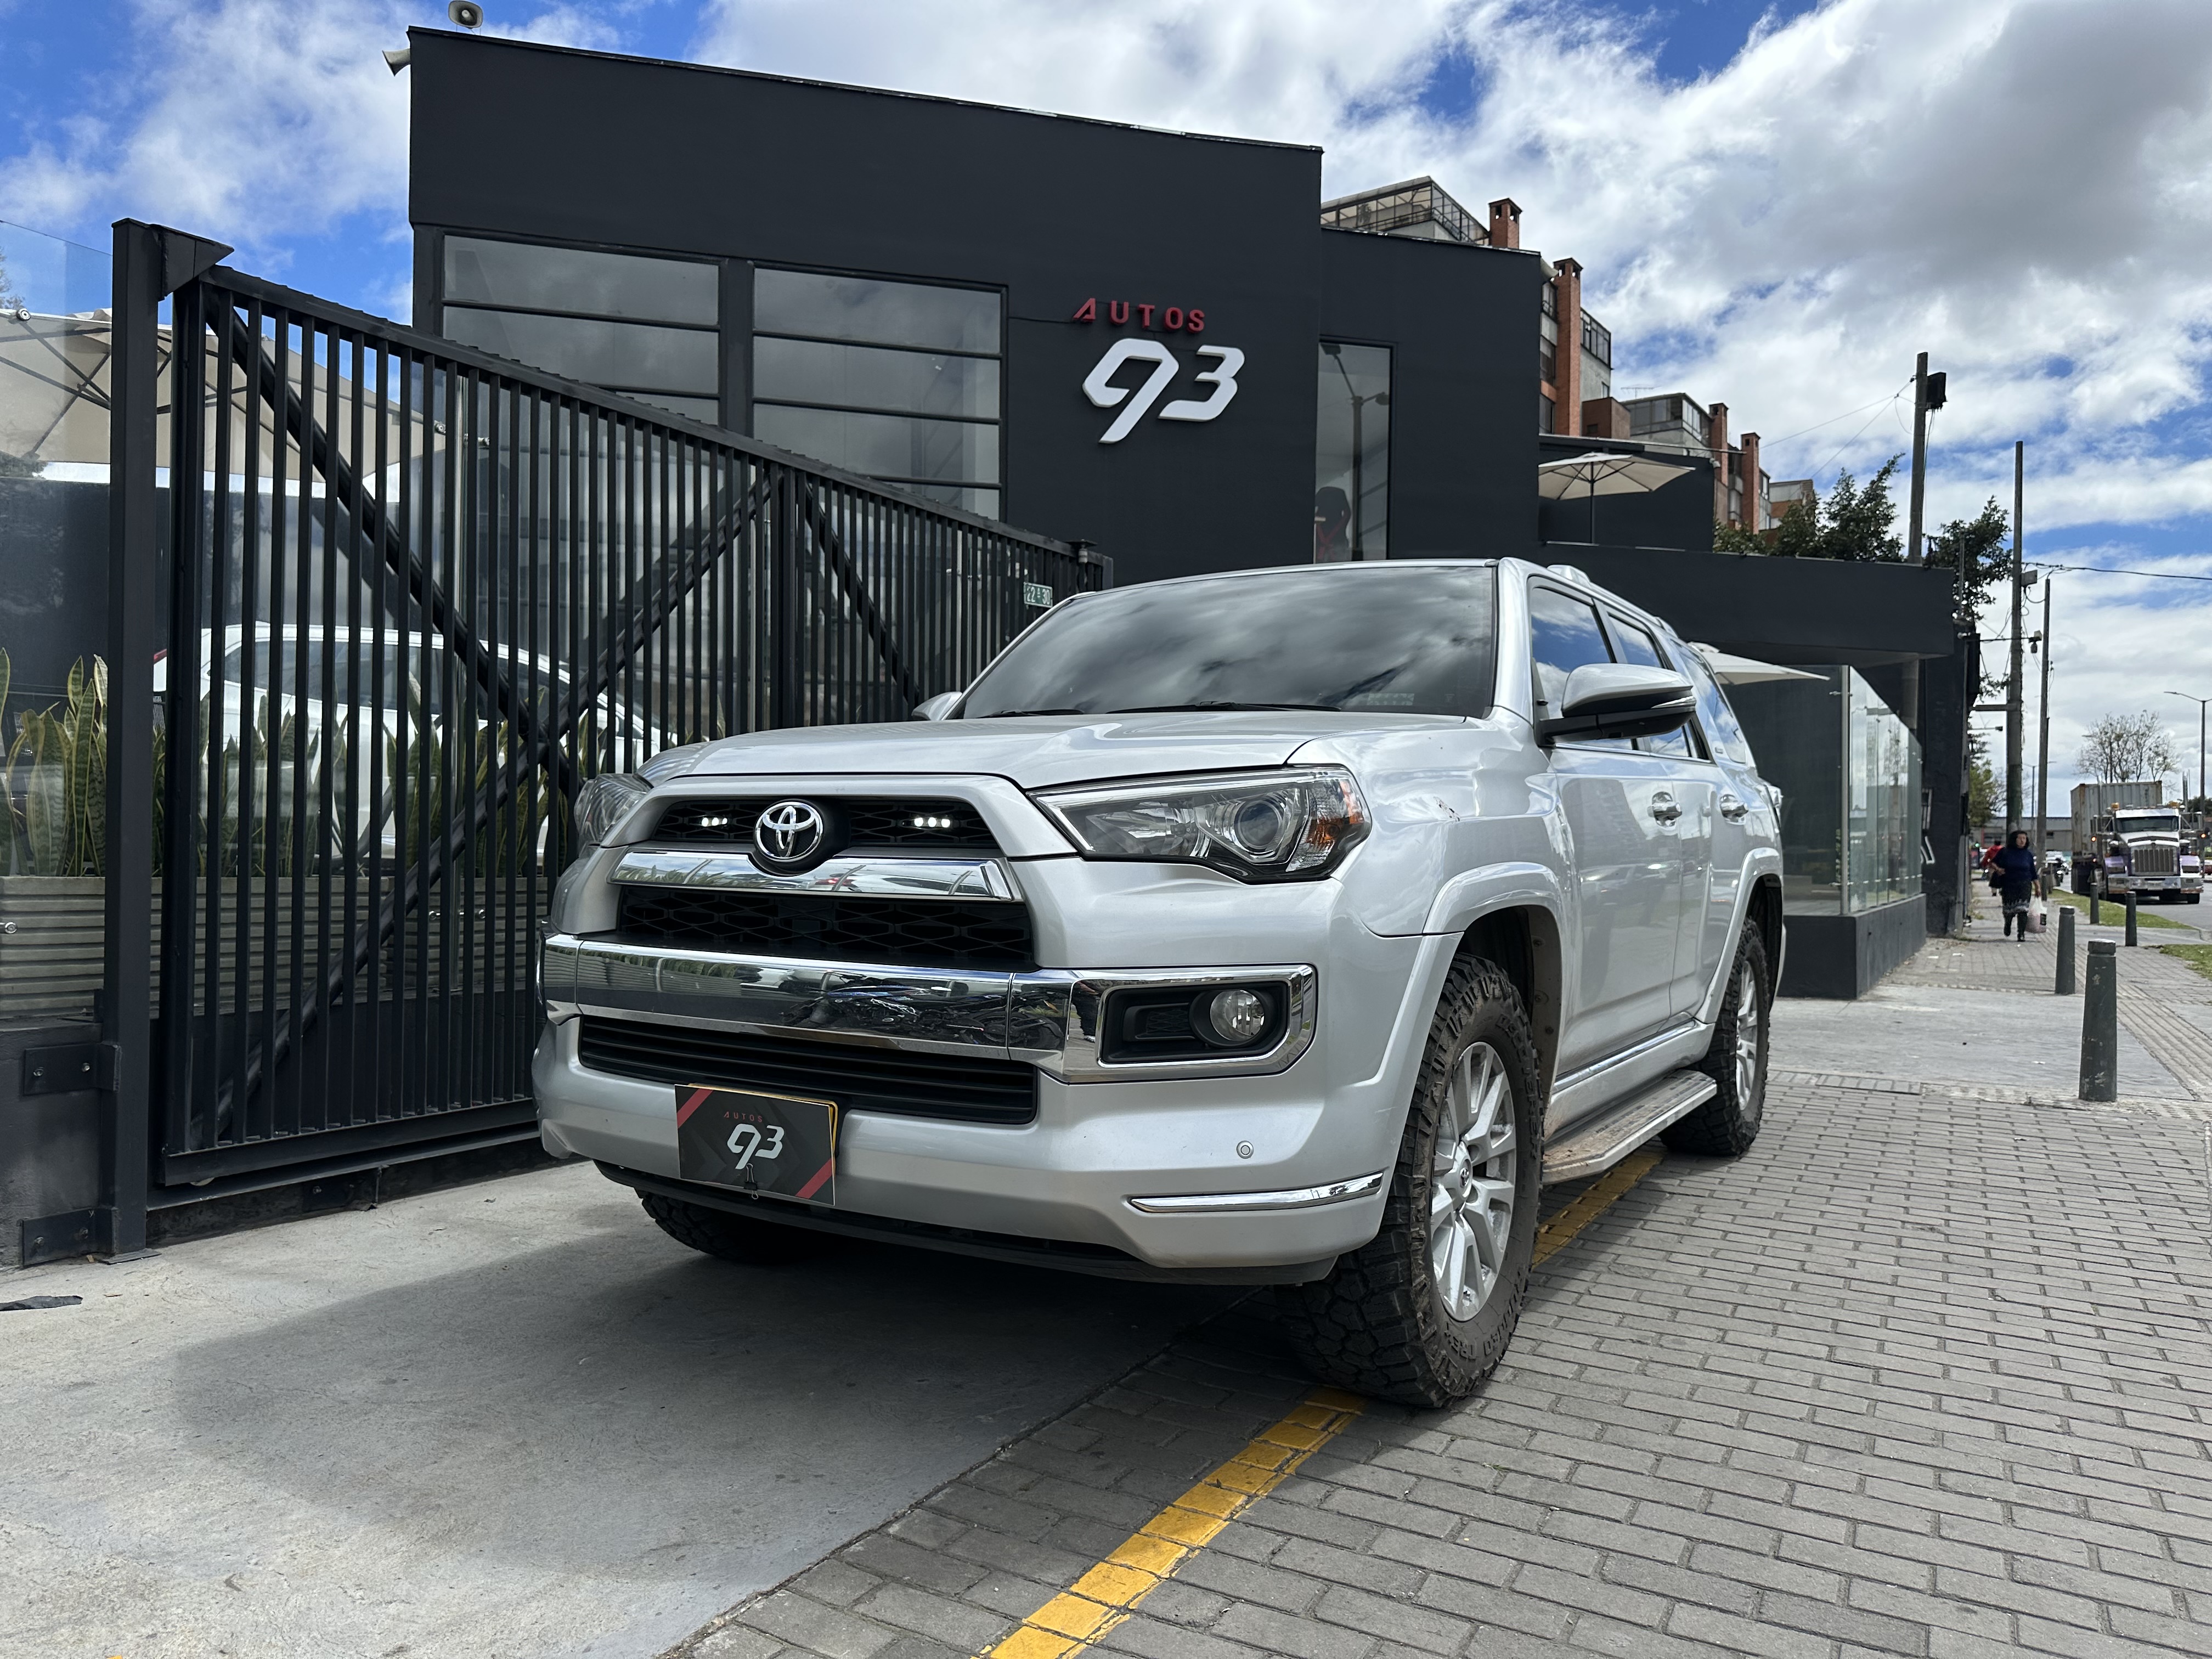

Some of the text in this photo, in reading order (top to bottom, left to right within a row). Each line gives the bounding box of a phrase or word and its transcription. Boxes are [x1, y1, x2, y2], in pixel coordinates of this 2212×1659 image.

[1073, 297, 1206, 334] AUTOS
[1082, 337, 1245, 444] 93
[723, 1111, 763, 1123] AUTOS
[726, 1123, 785, 1170] 93
